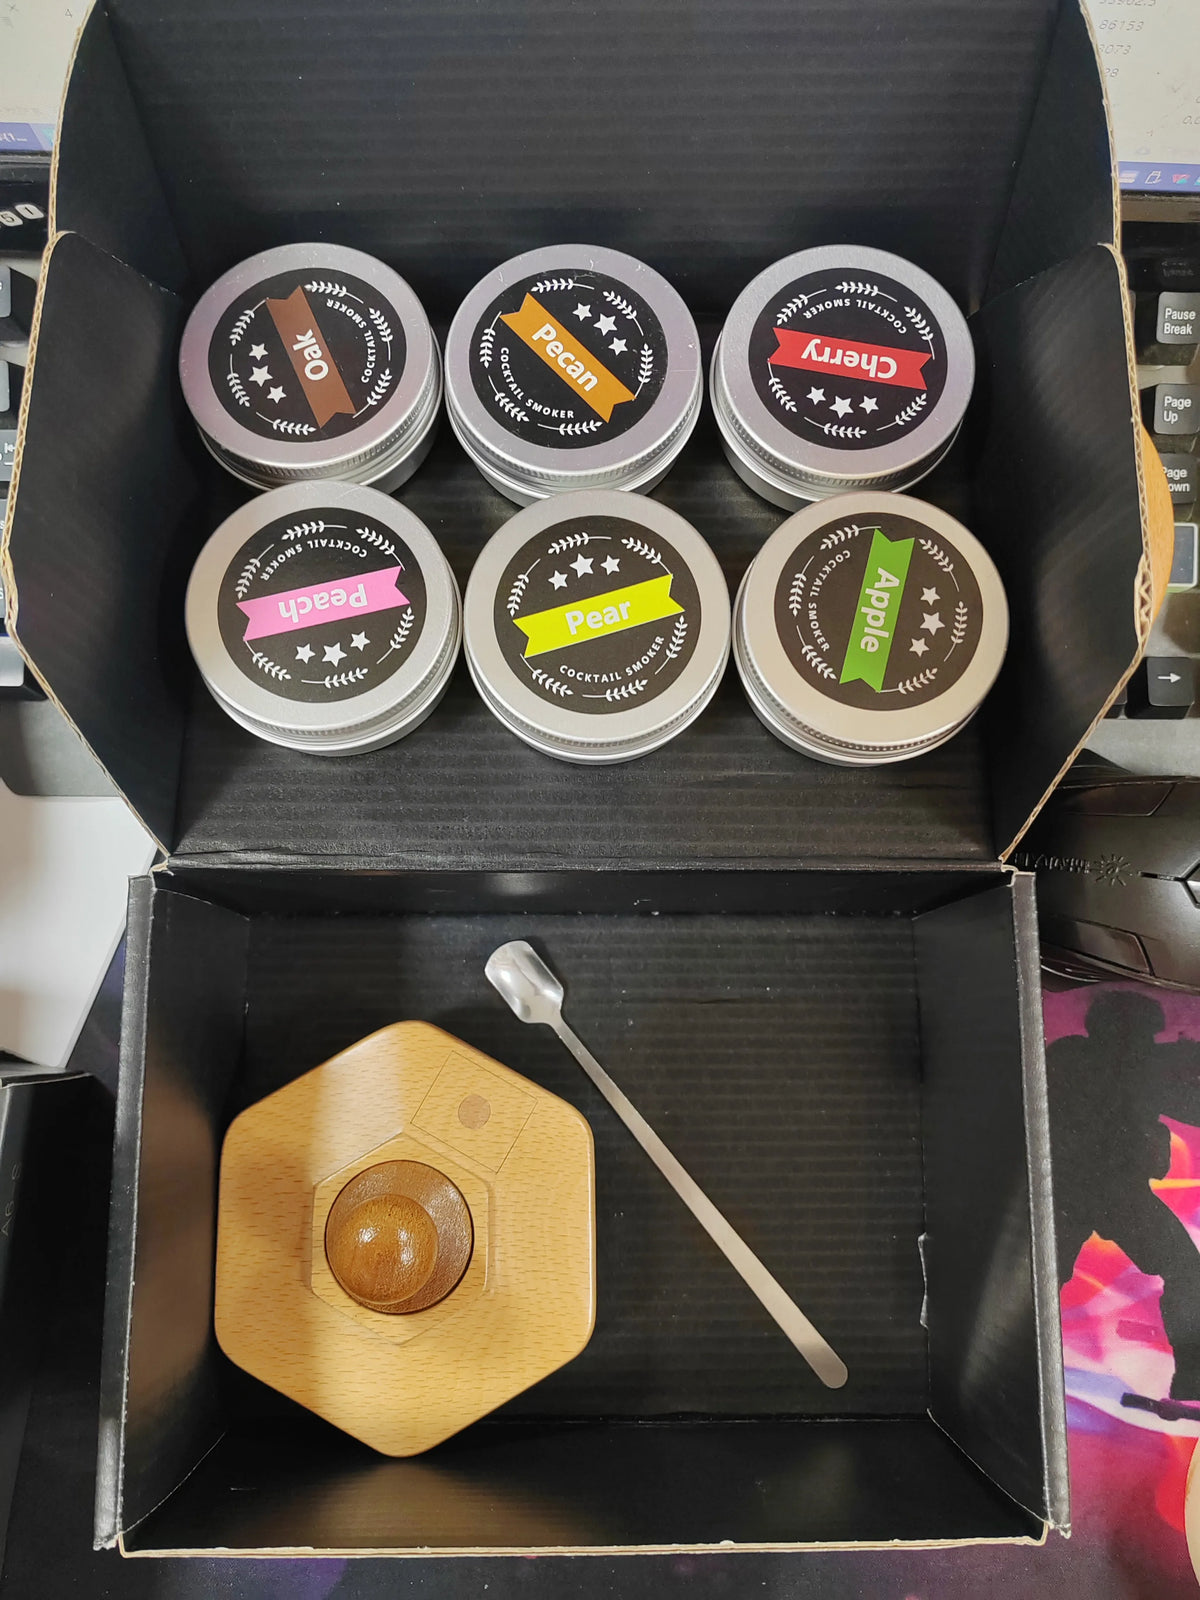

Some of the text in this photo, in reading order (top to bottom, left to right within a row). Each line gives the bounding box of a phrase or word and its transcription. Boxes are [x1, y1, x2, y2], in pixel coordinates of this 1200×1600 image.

[803, 298, 907, 334] COCKTAIL SMOKER
[1163, 322, 1193, 335] Break
[1165, 307, 1196, 320] Pause
[292, 329, 329, 381] Oak
[326, 299, 376, 383] COCKTAIL SMOKER
[531, 323, 598, 392] Pecan
[801, 338, 897, 379] Cherry
[500, 347, 575, 419] COCKTAIL SMOKER
[1164, 396, 1191, 410] Page
[1163, 410, 1178, 424] Up
[1168, 482, 1190, 492] own
[260, 538, 367, 581] COCKTAIL SMOKER
[278, 583, 368, 623] Peach
[565, 601, 630, 635] Pear
[808, 550, 850, 652] COCKTAIL SMOKER
[860, 567, 900, 653] Apple
[559, 636, 664, 683] COCKTAIL SMOKER
